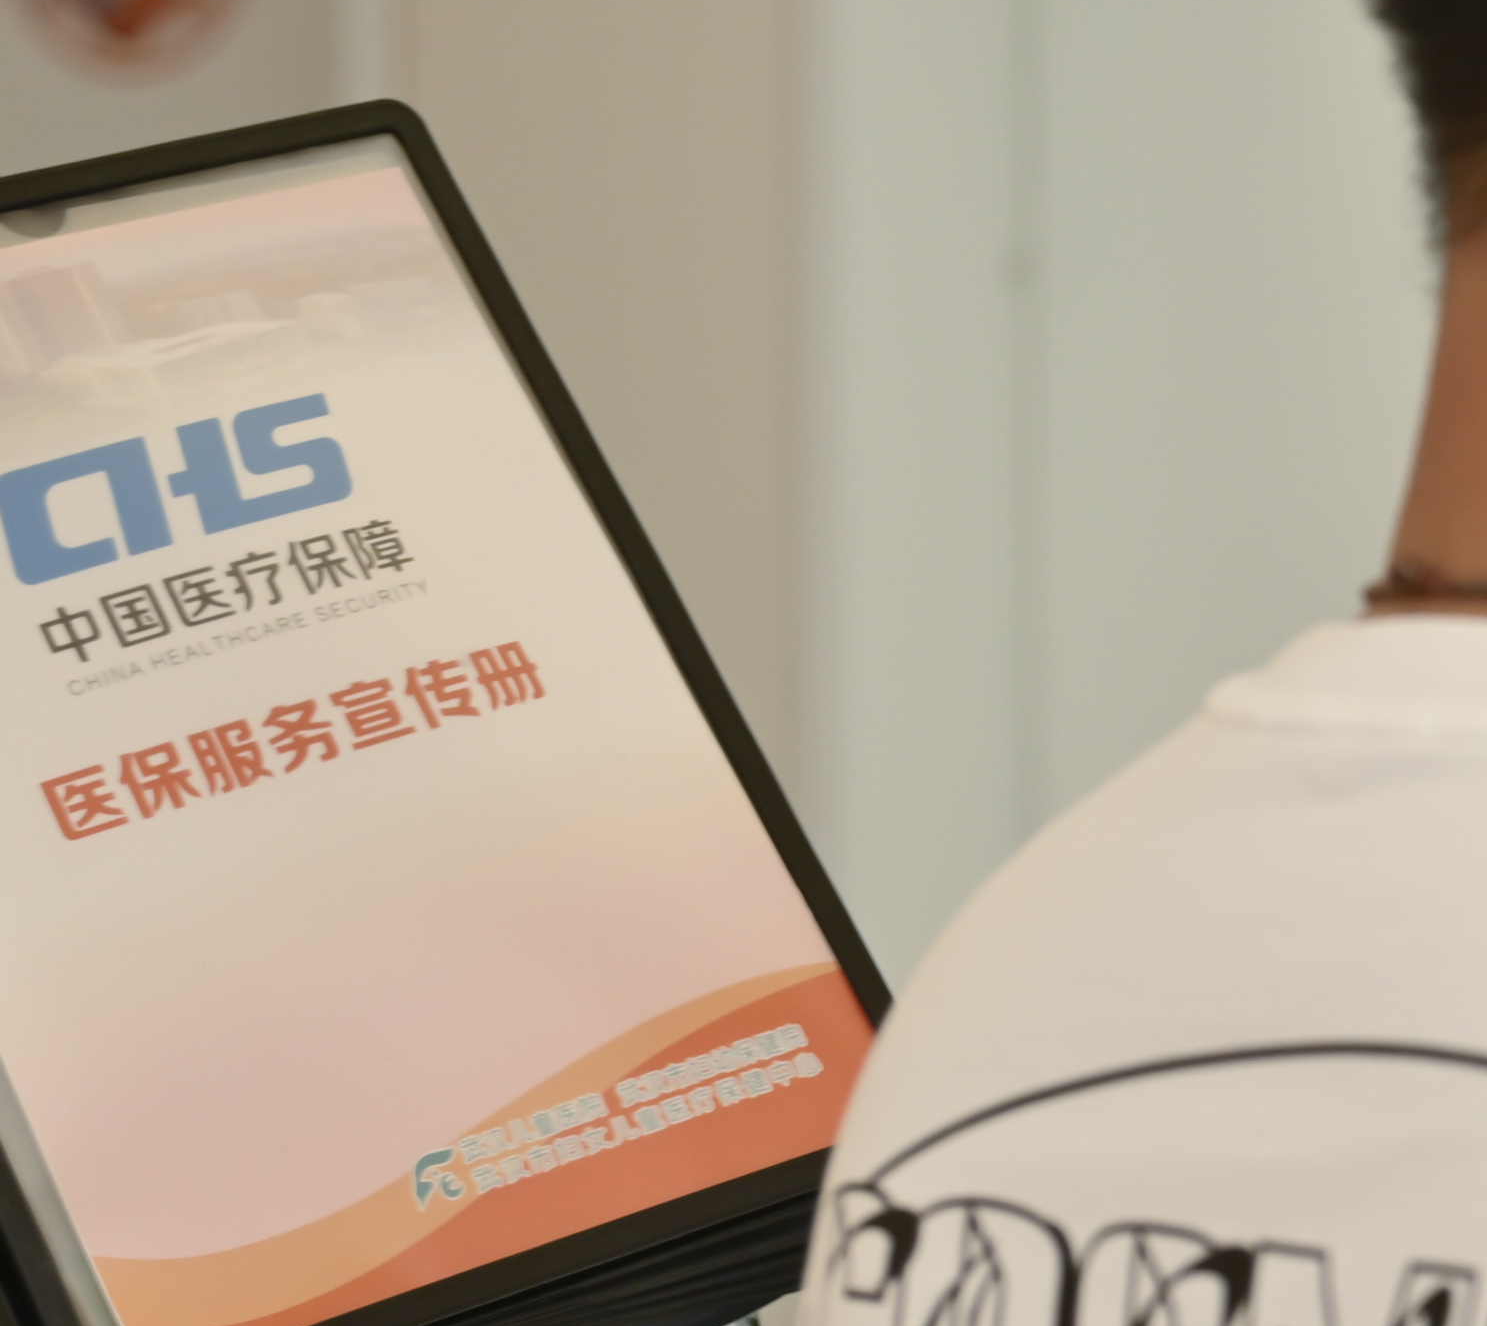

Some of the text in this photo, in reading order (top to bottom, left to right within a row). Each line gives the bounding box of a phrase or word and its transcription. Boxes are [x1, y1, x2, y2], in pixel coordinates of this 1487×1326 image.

[0, 391, 354, 587] CHS
[37, 519, 416, 664] 中国医疗保障
[67, 579, 430, 698] CHINA HEALTHCARE SECURITY
[39, 640, 548, 843] 医保服务宣传册
